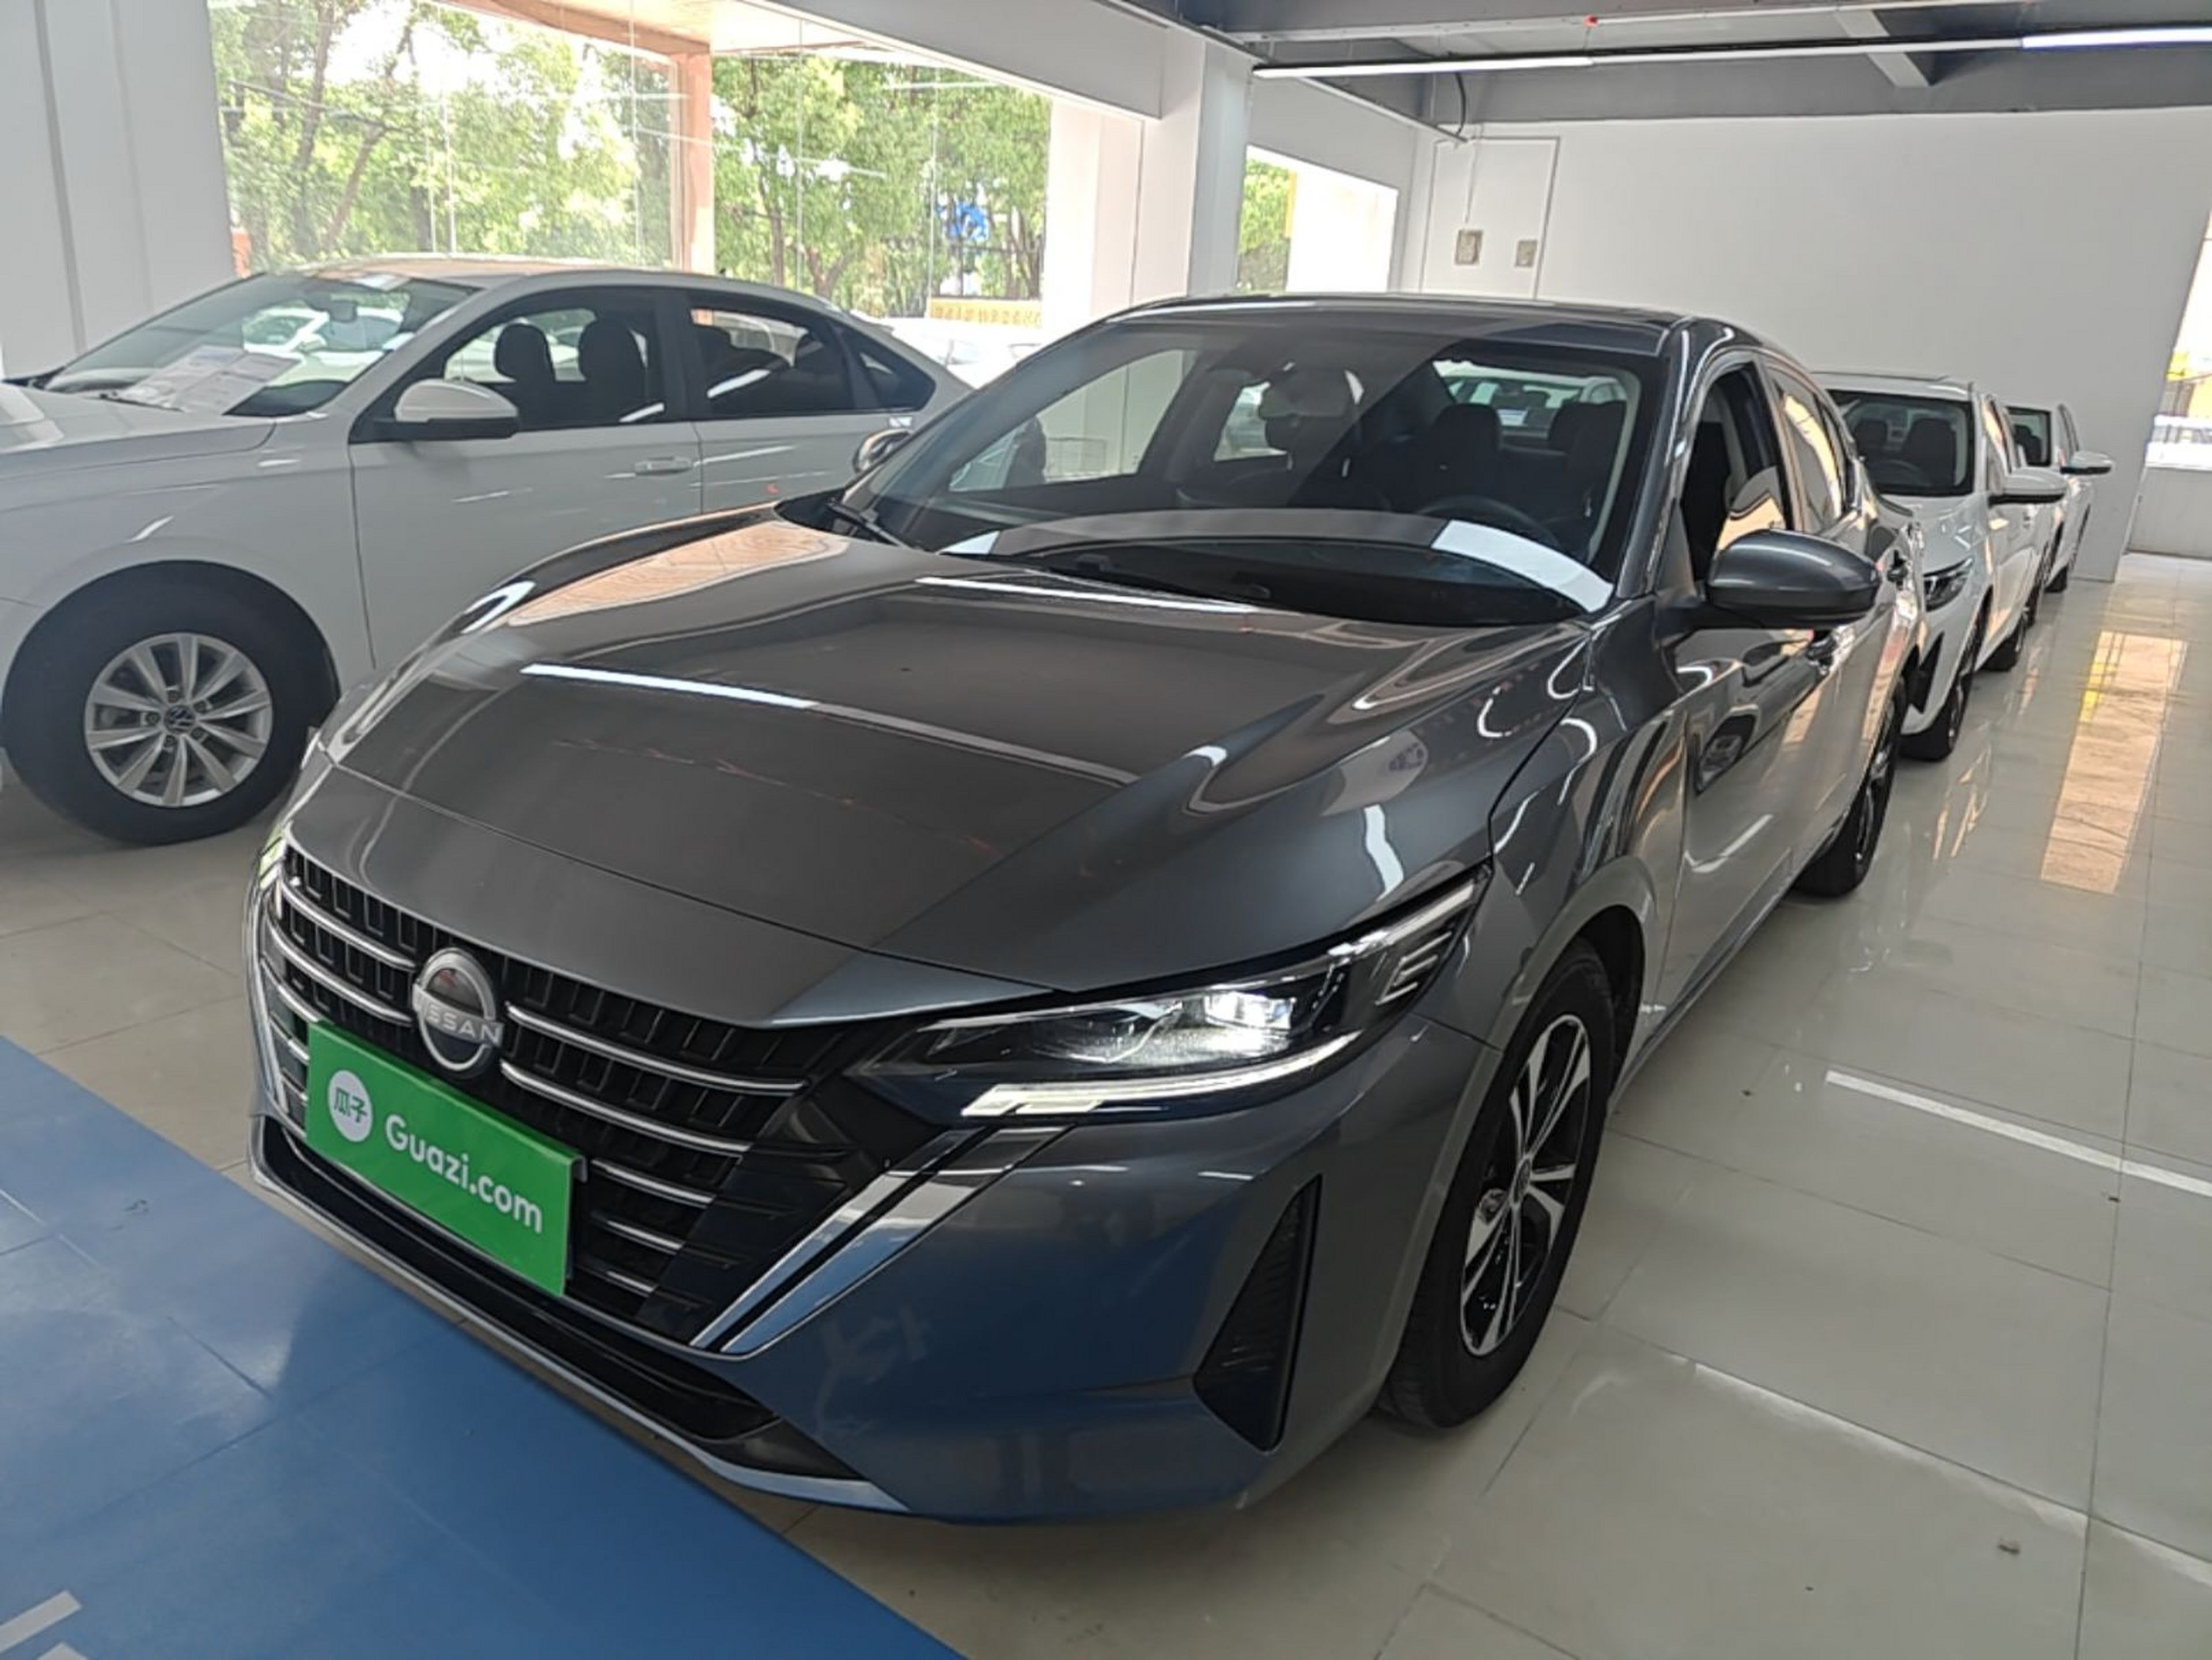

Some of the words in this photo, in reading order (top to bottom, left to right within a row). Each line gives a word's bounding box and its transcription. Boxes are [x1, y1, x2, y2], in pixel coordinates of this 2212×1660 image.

[415, 989, 503, 1046] SSAN
[334, 1087, 368, 1122] 瓜子
[385, 1114, 542, 1234] Guazi.com
